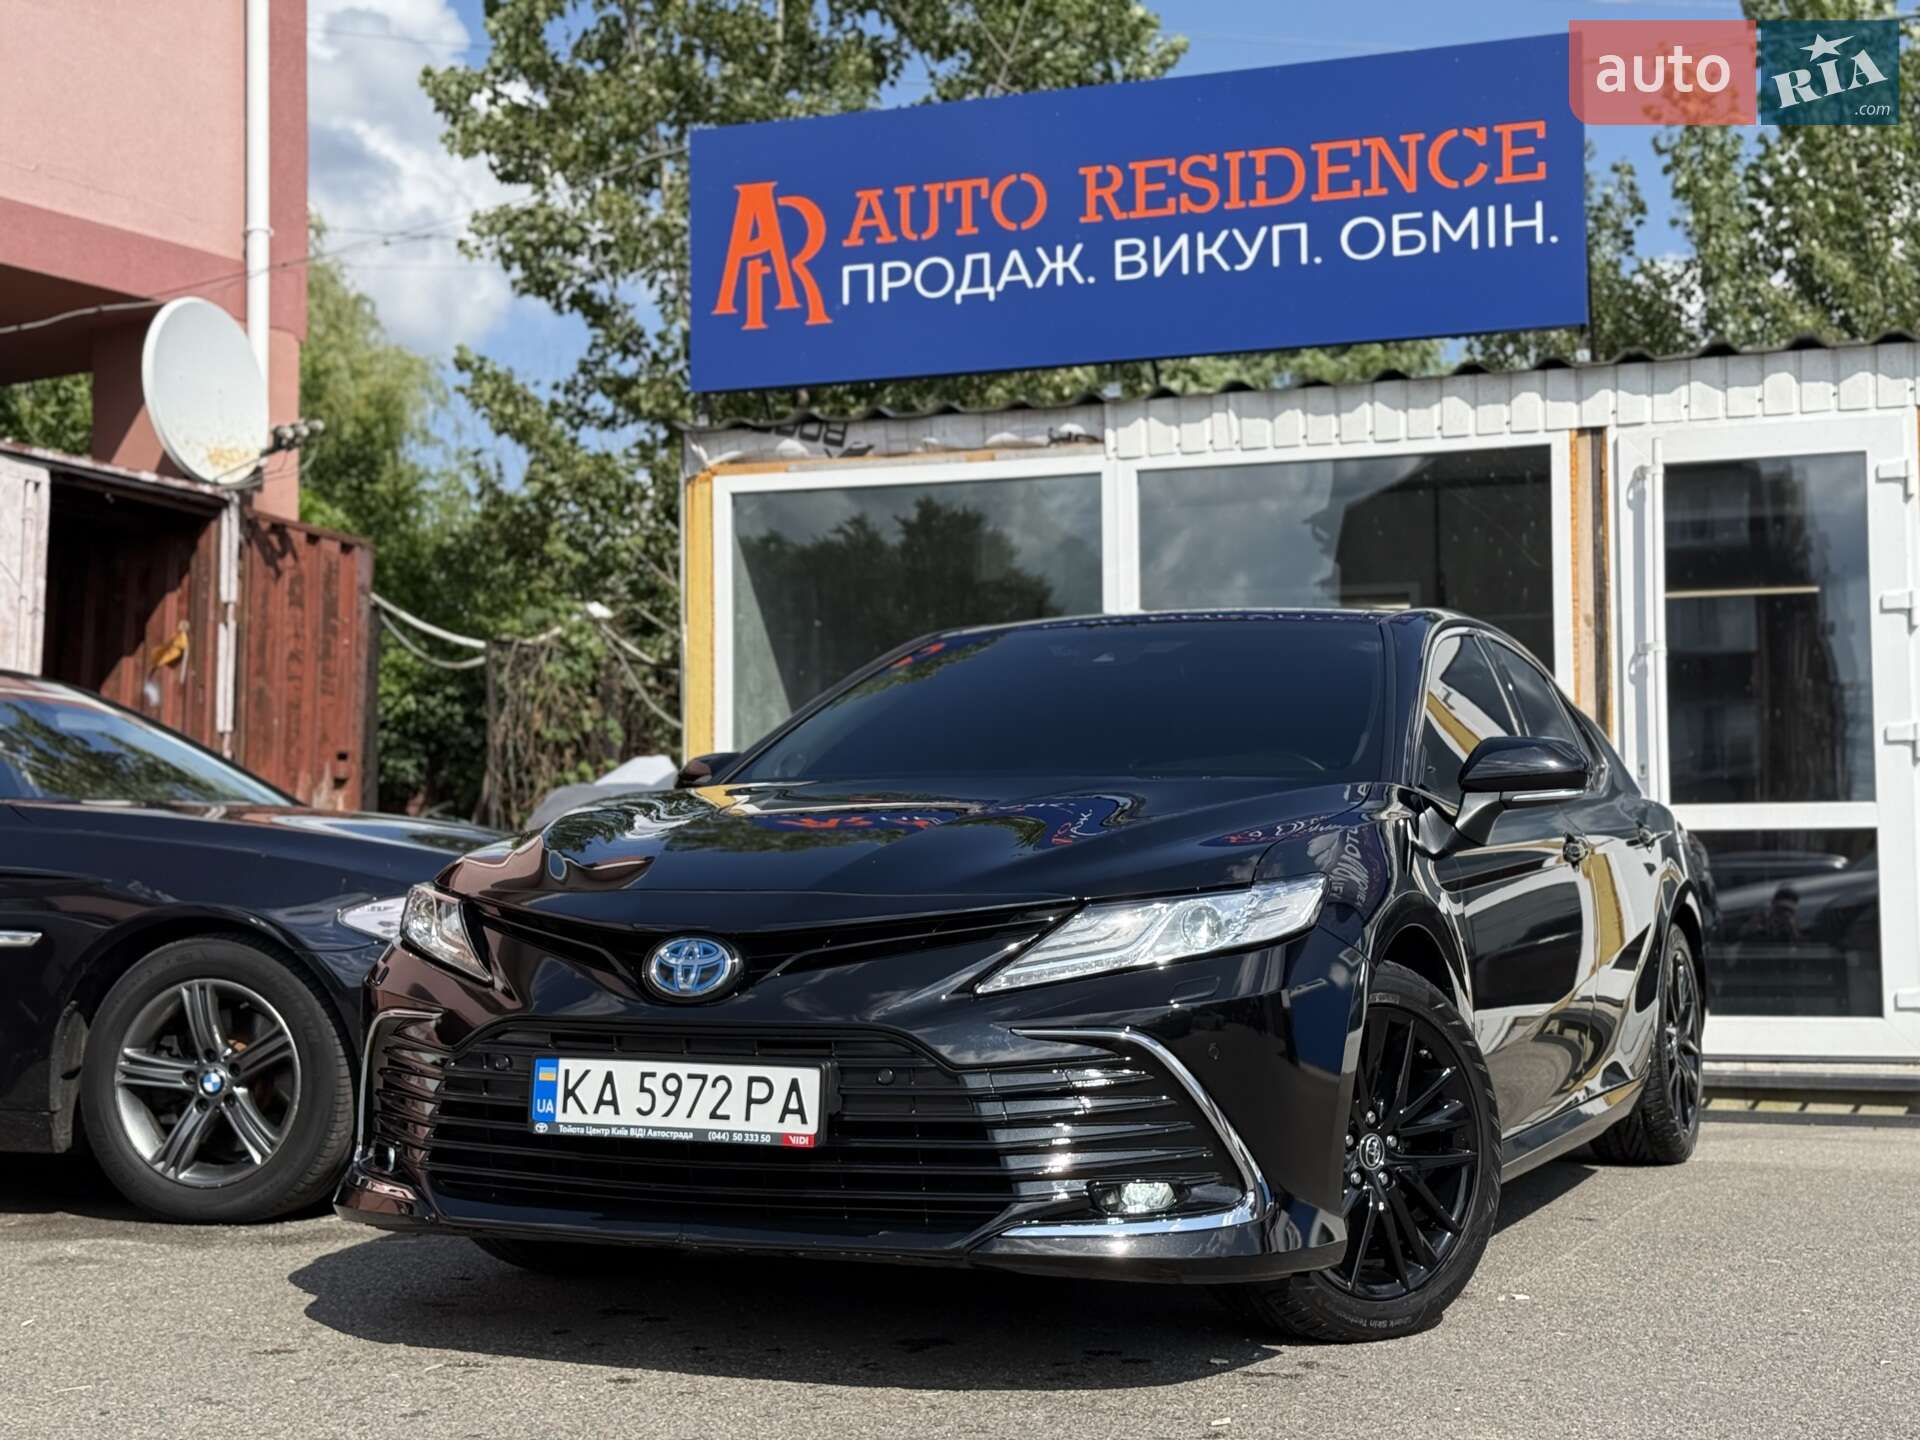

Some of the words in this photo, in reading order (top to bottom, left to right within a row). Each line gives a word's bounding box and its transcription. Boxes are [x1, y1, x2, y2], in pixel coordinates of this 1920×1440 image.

[842, 173, 1047, 247] AUTO
[1079, 120, 1548, 224] RESIDENCE
[842, 243, 1096, 305] ПРОДАЖ.
[1114, 222, 1323, 282] ВИКУП.
[1340, 201, 1559, 260] ОБМІН.
[561, 1068, 620, 1116] KA
[636, 1071, 733, 1121] 5972
[744, 1075, 808, 1125] PA
[537, 1098, 554, 1114] UA
[558, 1124, 585, 1134] Тойота
[585, 1126, 610, 1136] Центр
[647, 1129, 693, 1139] Автострада
[708, 1131, 730, 1142] (044)
[732, 1132, 743, 1141] 50
[743, 1133, 759, 1142] 333
[760, 1134, 771, 1143] 50
[788, 1135, 809, 1145] VIDI
